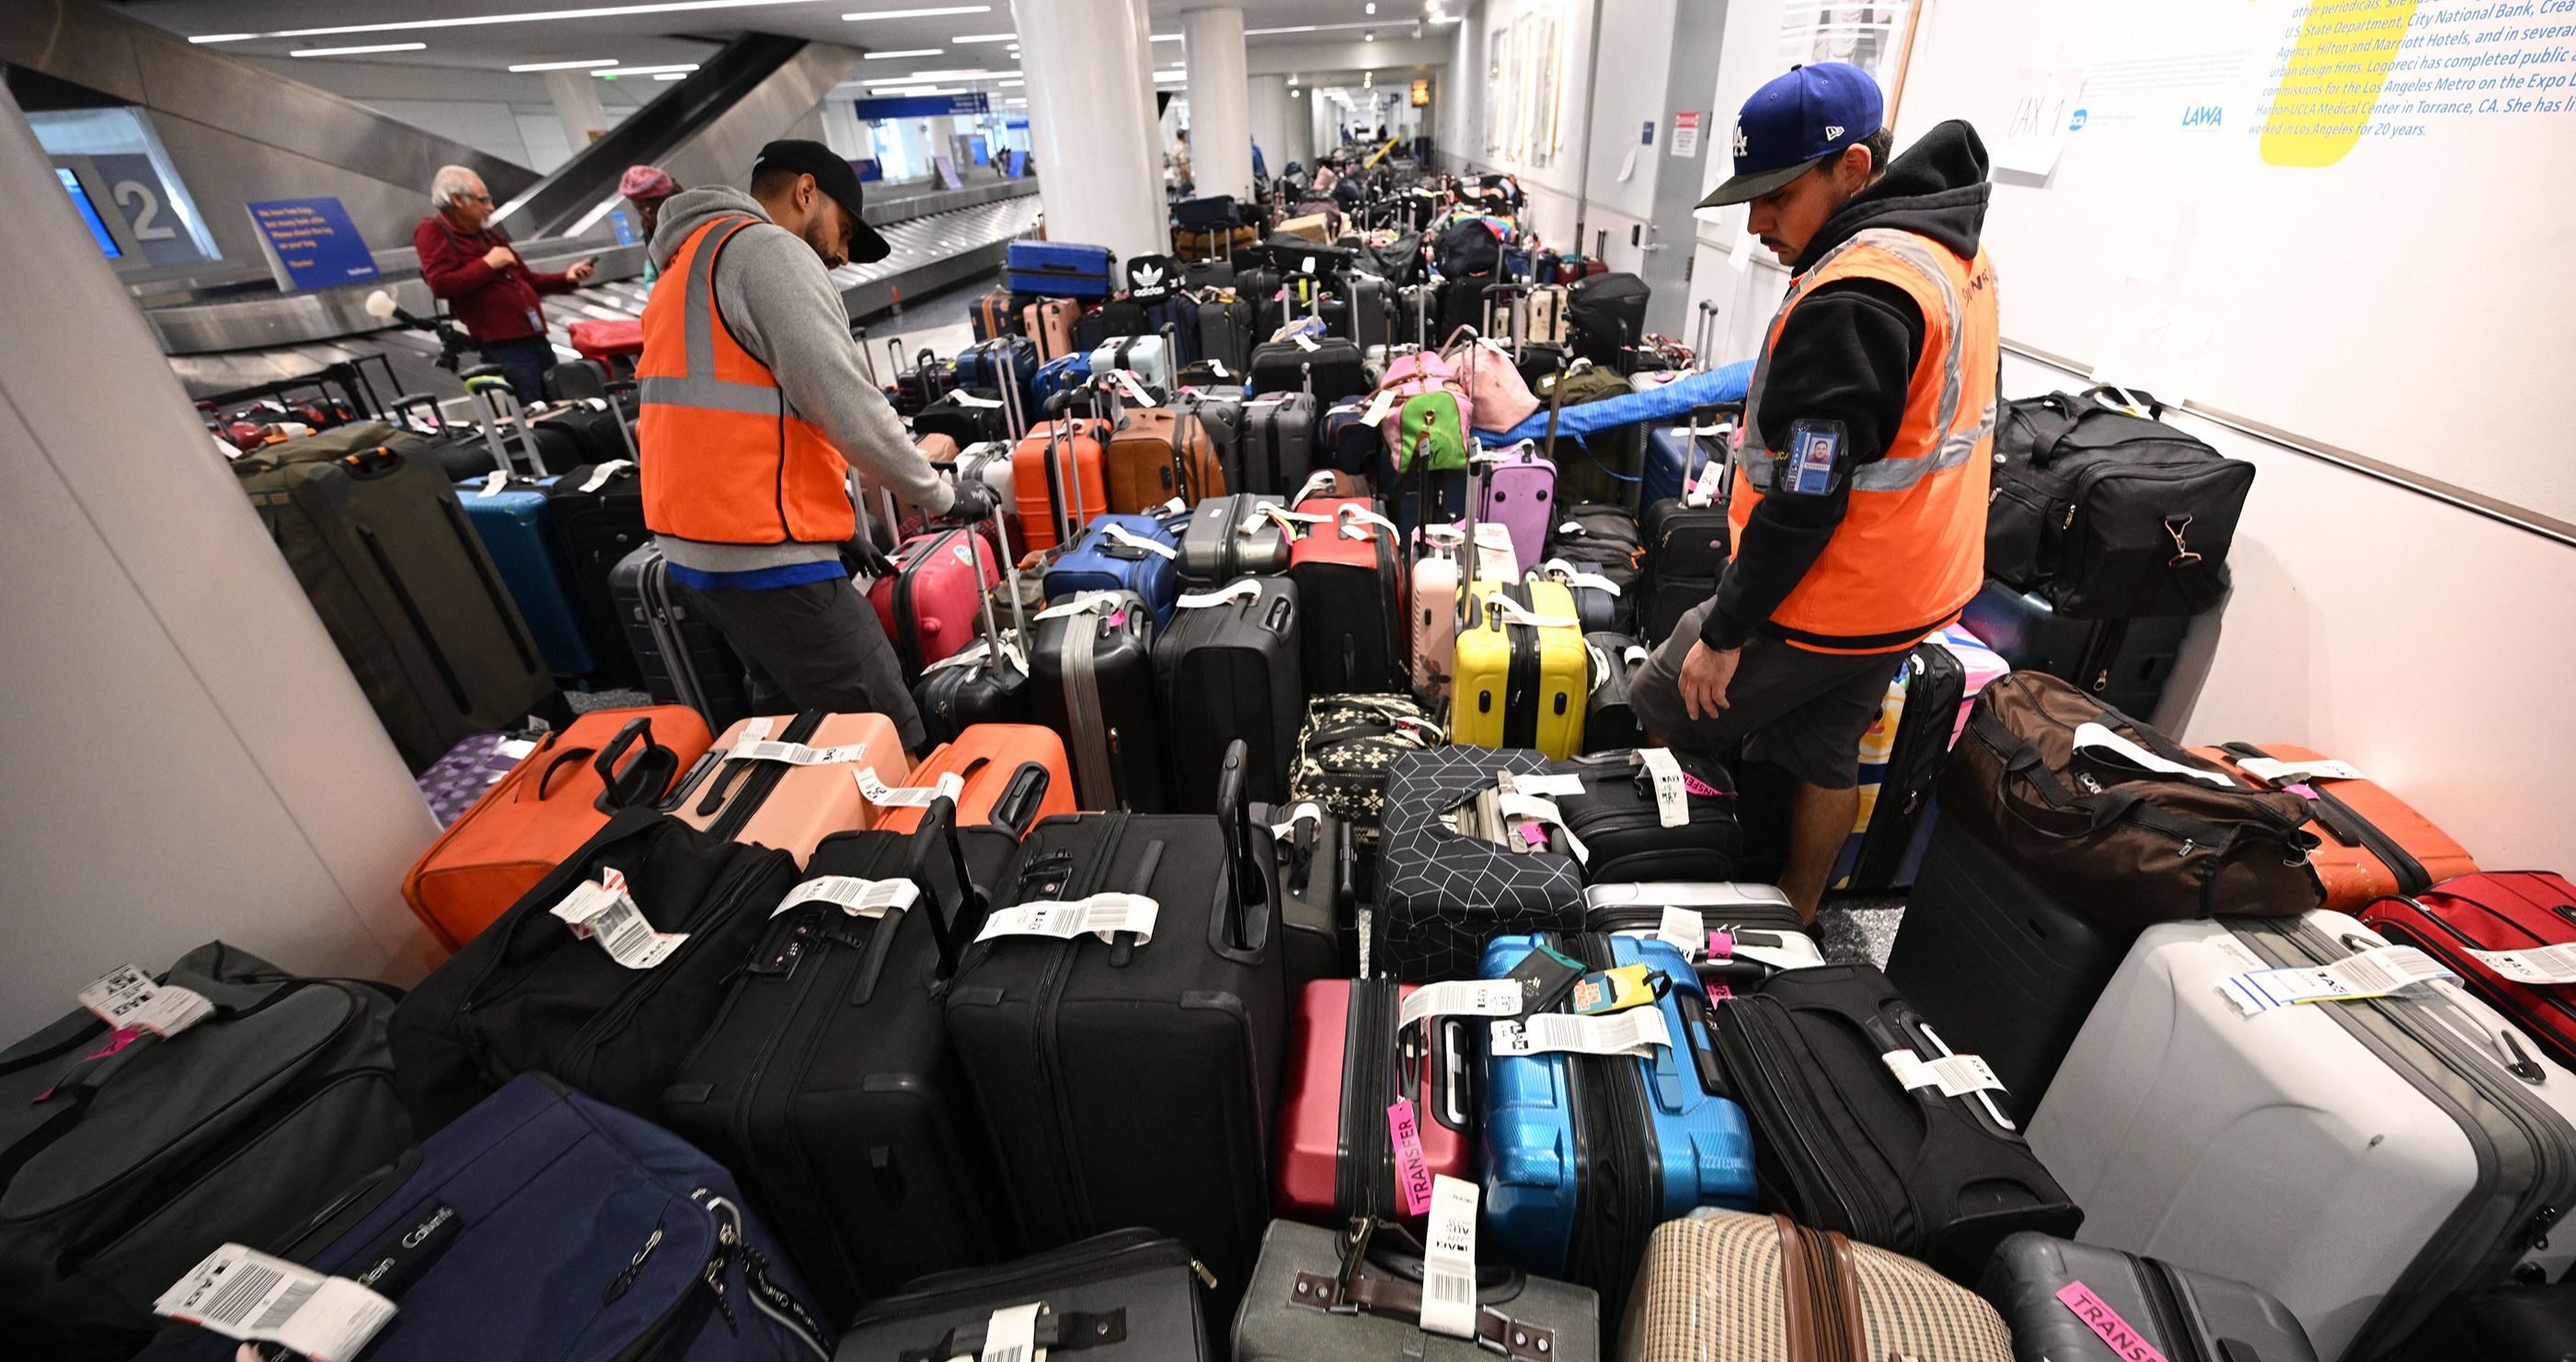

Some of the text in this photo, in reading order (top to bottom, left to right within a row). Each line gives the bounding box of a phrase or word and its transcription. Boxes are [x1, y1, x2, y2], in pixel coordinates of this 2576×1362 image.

[2292, 6, 2319, 18] other
[2319, 0, 2382, 18] periodicals.
[2304, 23, 2332, 37] State
[2333, 16, 2404, 36] Department,
[2408, 13, 2433, 29] City
[2434, 3, 2495, 24] National
[2495, 1, 2535, 19] Bank,
[2276, 46, 2314, 61] Agency,
[2316, 41, 2347, 55] Hilton
[2350, 38, 2373, 52] and
[2373, 35, 2425, 52] Marriott
[2426, 29, 2471, 47] Hotels,
[2475, 27, 2504, 44] and
[2504, 26, 2519, 41] in
[2270, 64, 2298, 78] urban
[2299, 63, 2332, 79] design
[2334, 60, 2363, 75] firms.
[2366, 55, 2419, 75] Logoreci
[2420, 54, 2443, 70] has
[2444, 48, 2522, 72] completed
[2519, 46, 2570, 68] public
[2262, 85, 2323, 98] commissions
[2325, 82, 2342, 97] for
[2342, 80, 2362, 94] the
[2363, 79, 2383, 93] Los
[2384, 77, 2432, 97] Angeles
[2433, 76, 2477, 92] Metro
[2478, 78, 2497, 89] on
[2499, 73, 2525, 89] the
[2526, 73, 2567, 92] Expo
[2007, 96, 2046, 138] LAX
[2181, 105, 2223, 127] LAWA
[2255, 102, 2315, 116] Harbor-UCLA
[2317, 100, 2360, 115] Medical
[2361, 100, 2400, 115] Center
[2400, 99, 2414, 114] in
[2416, 99, 2474, 116] Torrance,
[2478, 98, 2500, 114] CA.
[2503, 97, 2533, 114] She
[2534, 96, 2561, 113] has
[2248, 121, 2427, 140] worked in Los Angeles for 20 years.
[113, 179, 177, 241] 2
[1133, 285, 1166, 298] adidas
[1398, 1118, 1431, 1205] TRANSFER
